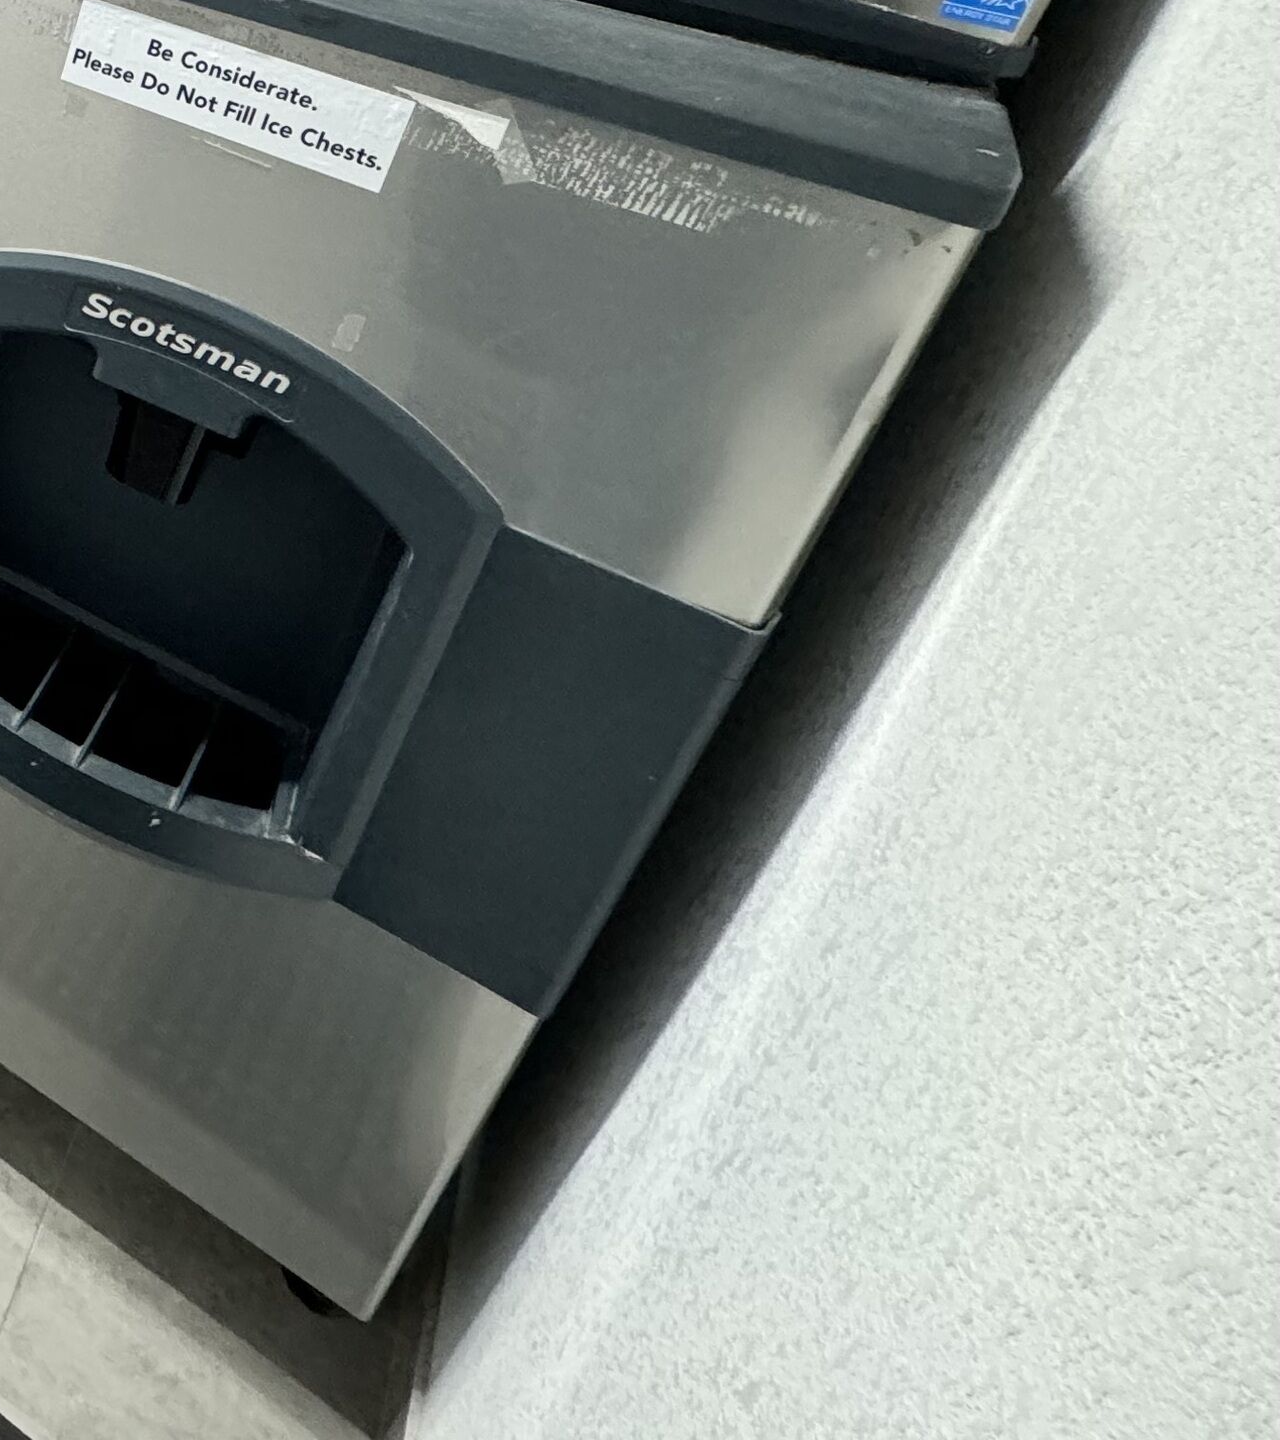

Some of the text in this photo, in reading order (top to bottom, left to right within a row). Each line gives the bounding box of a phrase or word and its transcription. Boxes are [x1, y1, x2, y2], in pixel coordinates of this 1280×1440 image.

[72, 48, 382, 171] Please Do Not Fill Ice Chests.
[146, 39, 318, 111] Be Considerate.
[82, 293, 291, 394] Scotsman
